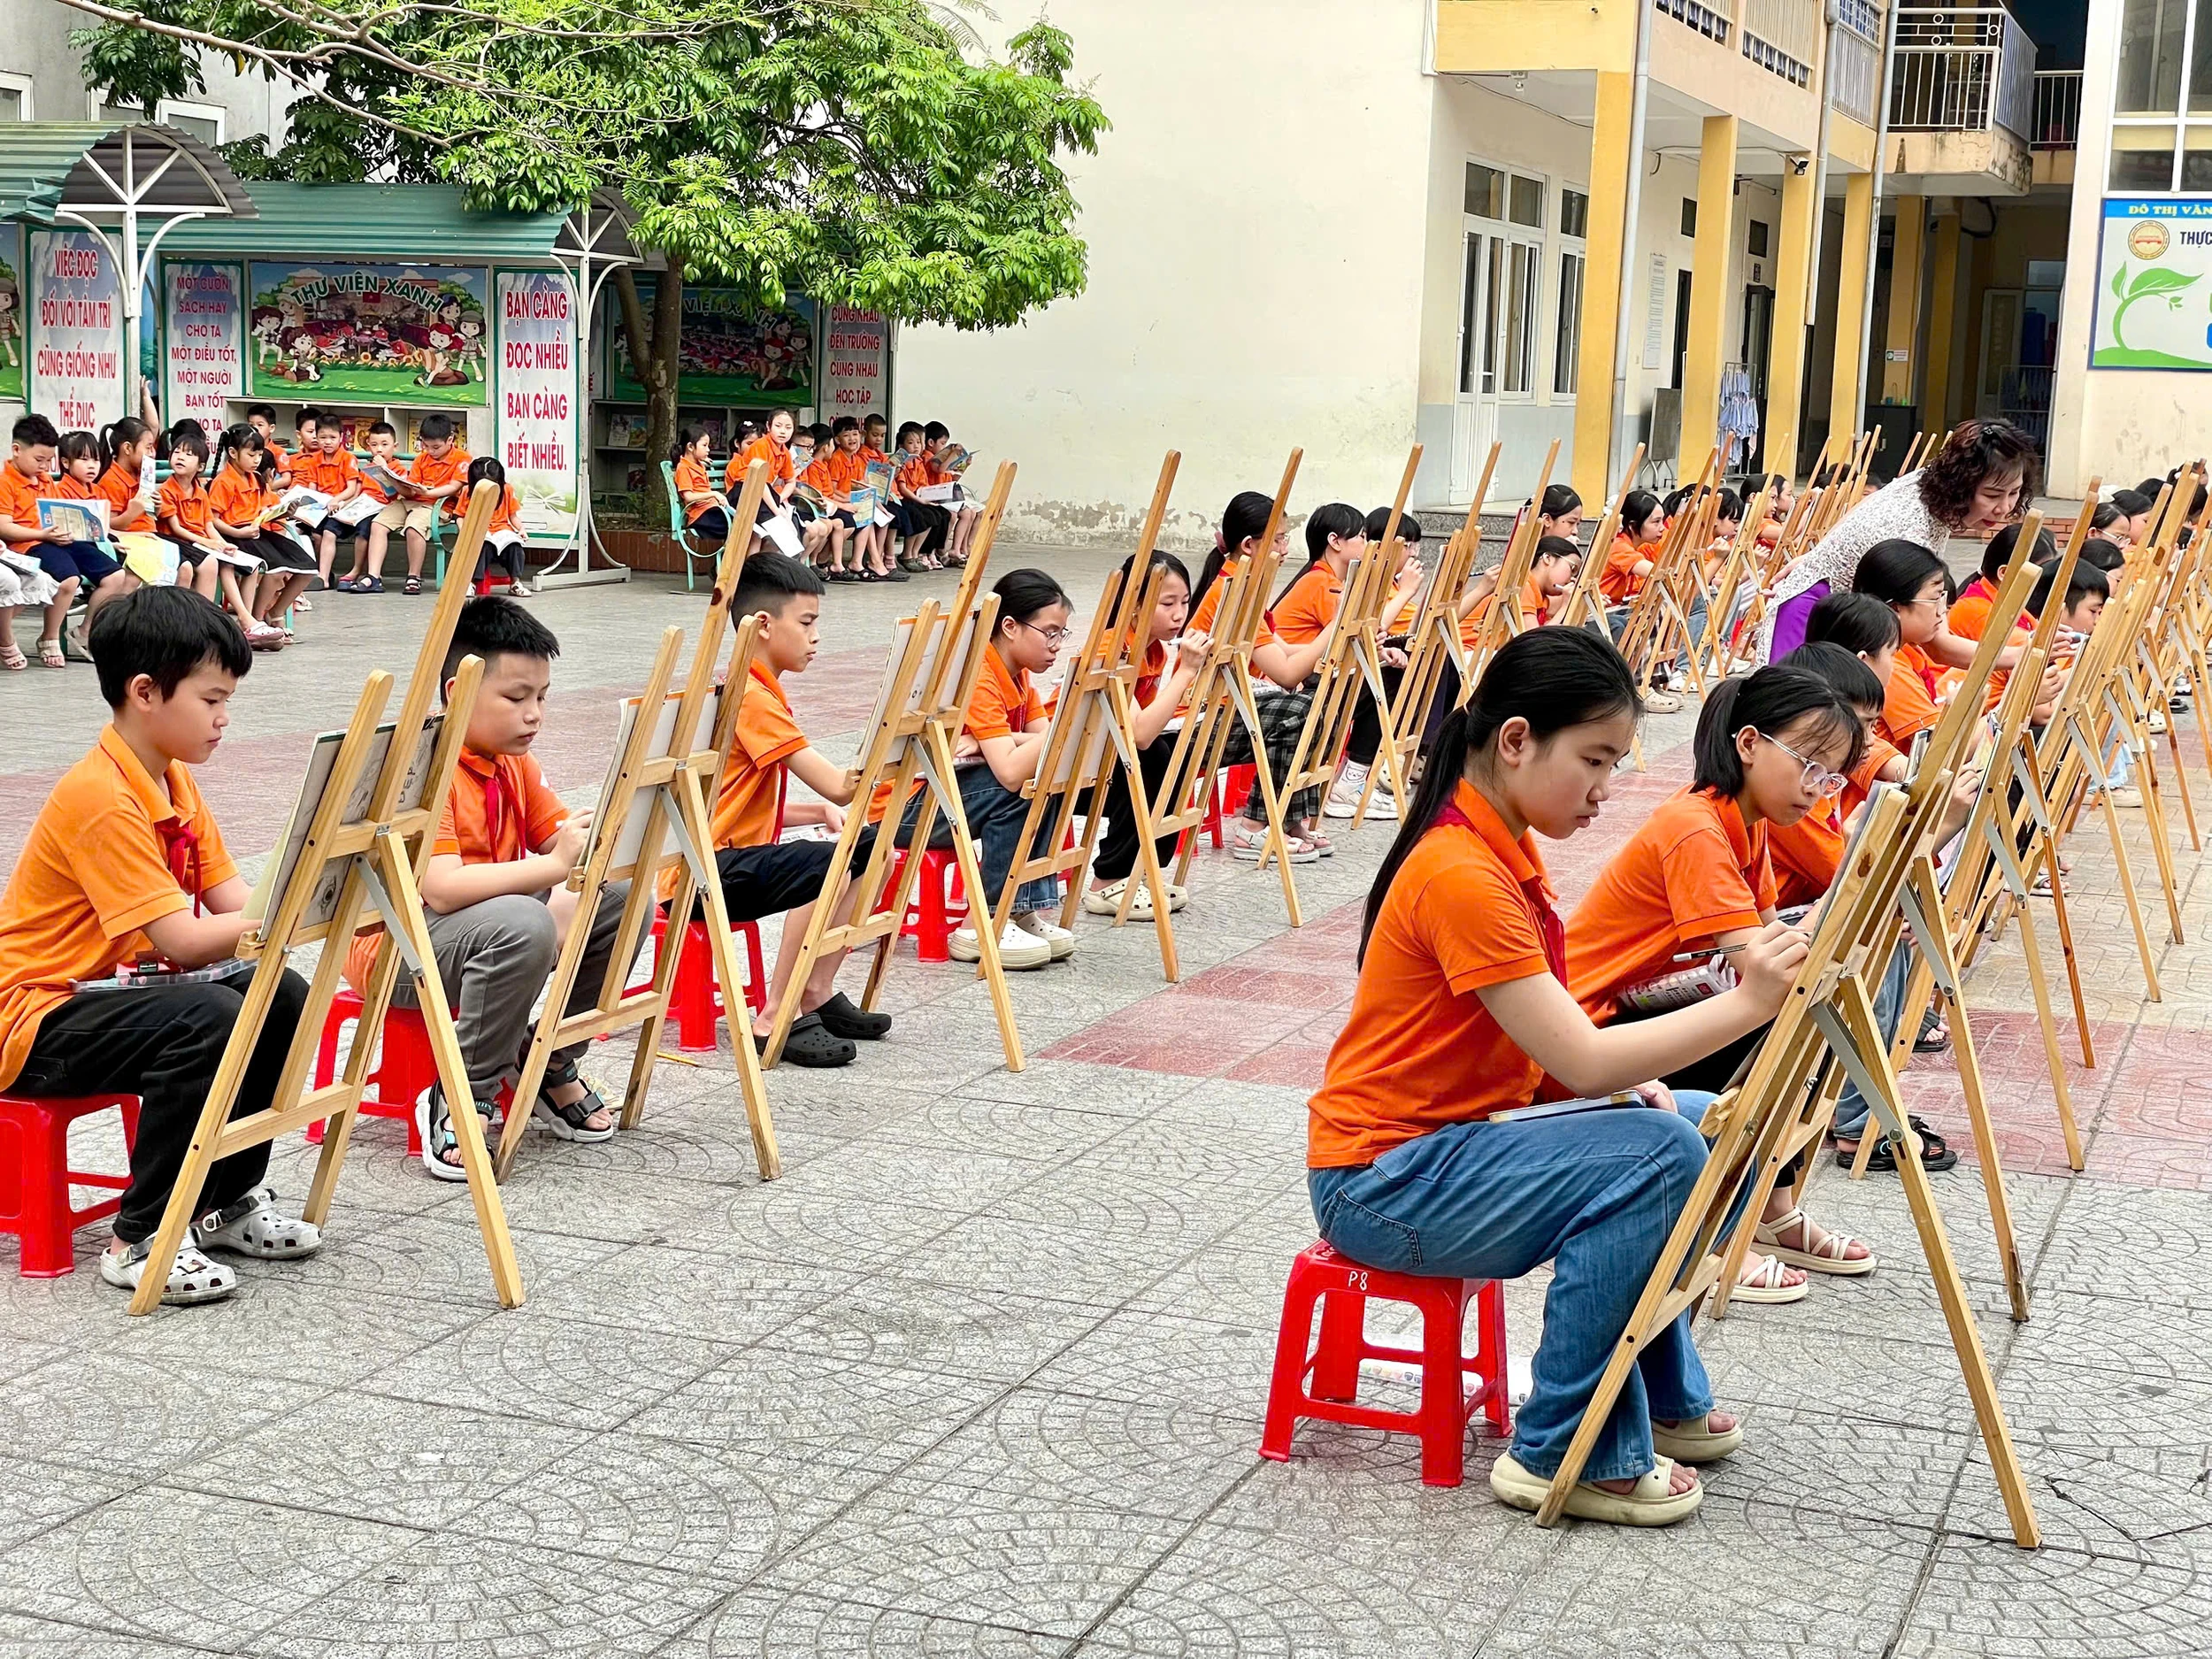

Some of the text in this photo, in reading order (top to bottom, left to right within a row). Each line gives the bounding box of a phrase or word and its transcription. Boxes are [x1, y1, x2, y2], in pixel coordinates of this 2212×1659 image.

[2153, 206, 2177, 217] THỊ
[55, 242, 97, 286] VIỆC ĐỌC
[200, 272, 229, 291] CUỐN
[289, 269, 444, 314] THƯ VIỆN XANH
[42, 288, 58, 326] ĐỐI
[78, 293, 96, 327] TÂM
[98, 294, 111, 328] TRÍ
[208, 302, 227, 314] HAY
[506, 284, 567, 326] BẠN CÀNG
[856, 307, 879, 323] NHAU
[185, 324, 221, 337] CHO TA
[829, 327, 879, 350] ĐẾN TRƯỜNG
[65, 341, 96, 379] GIỐNG
[97, 349, 117, 379] NHƯ
[172, 342, 237, 365] MỘT ĐIỀU TỐT,
[506, 330, 568, 376] ĐỌC NHIỀU
[177, 367, 232, 387] MỘT NGƯỜI
[830, 358, 878, 377] CÙNG NHAU
[58, 386, 74, 427] THỂ
[185, 390, 226, 411] BẠN TỐT
[507, 392, 530, 426] BẠN
[534, 386, 567, 420] CÀNG
[836, 386, 872, 409] HỌC TẬP
[508, 430, 567, 471] BIẾT NHIỀU.
[1348, 1271, 1369, 1291] P8
